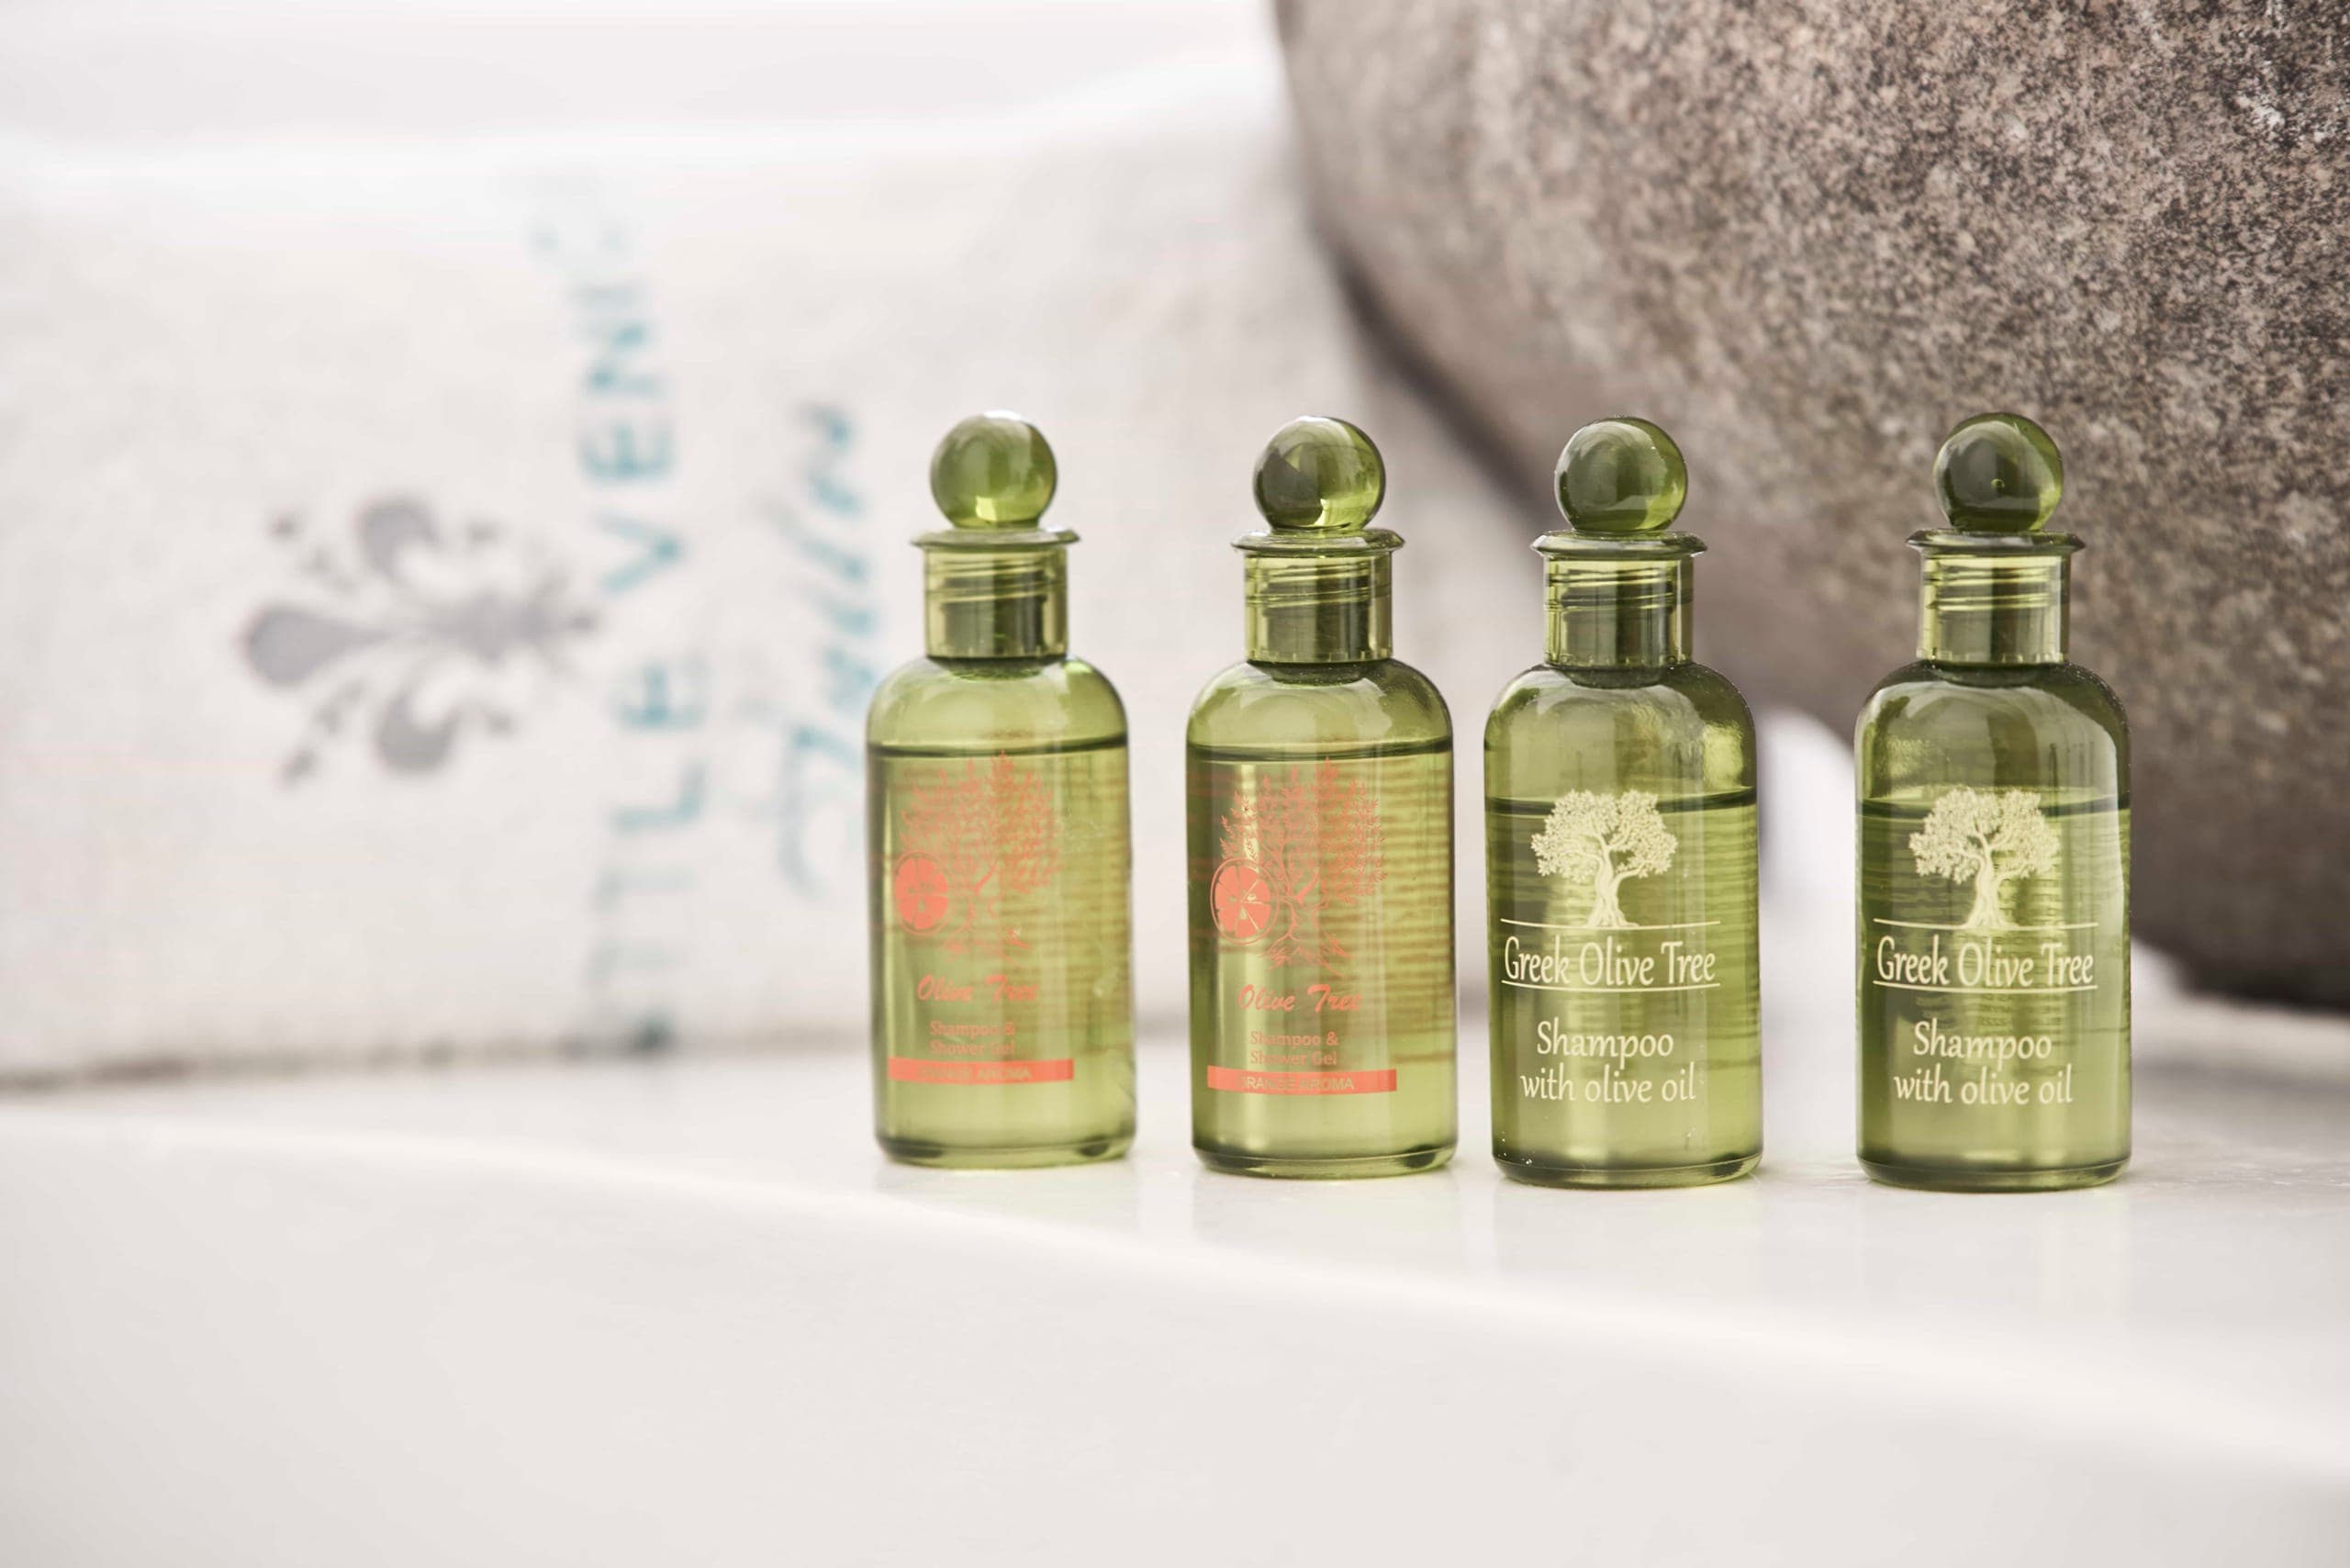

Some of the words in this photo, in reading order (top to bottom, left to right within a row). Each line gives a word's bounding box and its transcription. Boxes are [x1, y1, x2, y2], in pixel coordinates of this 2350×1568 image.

[1505, 934, 1571, 985] Greek
[1579, 935, 1654, 986] Olive
[1661, 939, 1716, 985] Tree
[1877, 934, 1950, 985] Greek
[1958, 935, 2034, 988] Olive
[2041, 941, 2094, 986] Tree
[917, 974, 974, 1003] Olive
[985, 974, 1040, 1003] Tree
[1237, 983, 1296, 1012] Olive
[1307, 983, 1362, 1014] Tree
[930, 1021, 1000, 1040] Shampoo
[1250, 1031, 1322, 1050] Shampoo
[1326, 1031, 1339, 1047] &
[1537, 1016, 1674, 1070] Shampoo
[1913, 1016, 2052, 1071] Shampoo
[1250, 1051, 1308, 1066] Shower
[1313, 1050, 1337, 1066] Gel
[1299, 1075, 1355, 1091] AROMA
[1520, 1061, 1575, 1102] with
[1584, 1064, 1652, 1103] olive
[1662, 1061, 1697, 1102] oil
[1894, 1062, 1953, 1104] with
[1961, 1065, 2031, 1105] olive
[2039, 1062, 2074, 1104] oil
